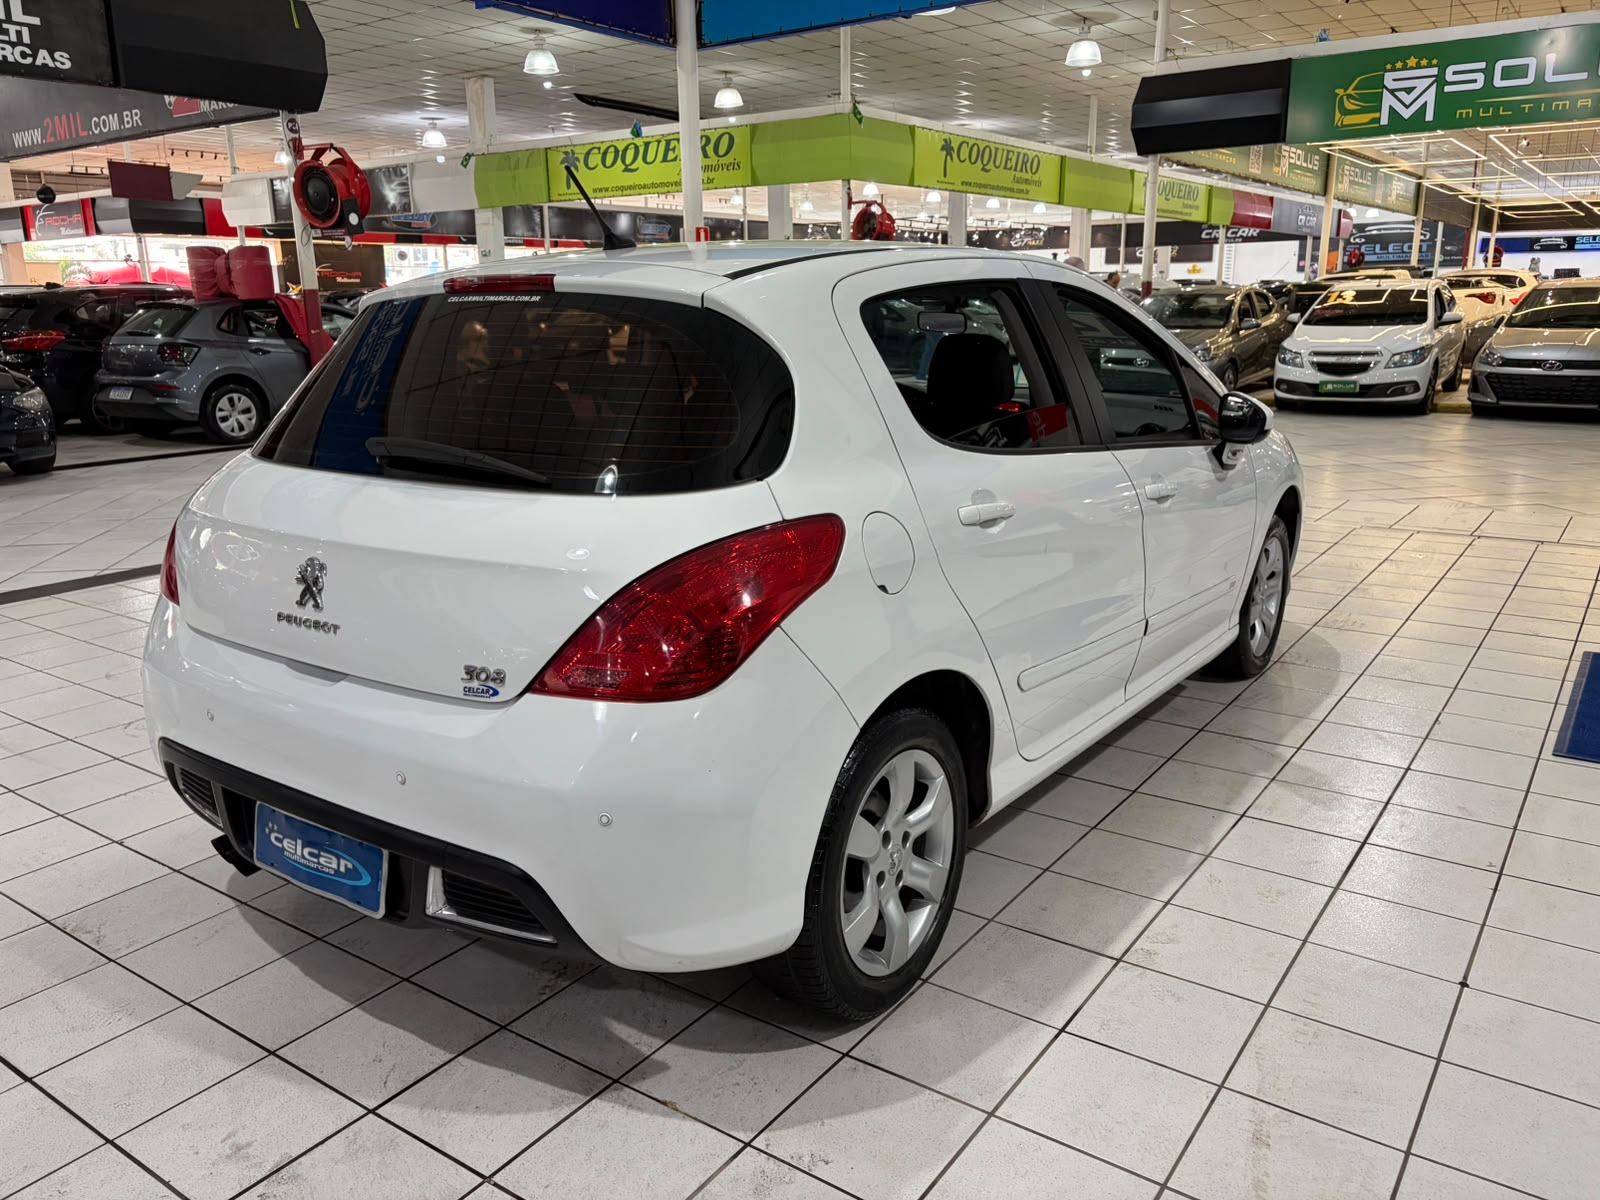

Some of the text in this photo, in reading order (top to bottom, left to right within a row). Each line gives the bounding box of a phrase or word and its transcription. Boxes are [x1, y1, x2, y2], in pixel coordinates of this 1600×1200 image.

[1443, 52, 1600, 93] SOL
[583, 131, 735, 174] COQUERO
[956, 140, 1041, 176] COQUEIRO
[1289, 146, 1320, 171] SOLUS
[676, 158, 742, 176] móveis
[1157, 178, 1200, 202] OQUEIRO
[1226, 227, 1260, 238] CAR
[448, 294, 541, 303] CELCARMULTIMARCAS.COM.BR
[276, 611, 341, 636] PEUGEOT
[460, 664, 507, 688] 308
[463, 685, 491, 696] CELCAR
[270, 832, 354, 874] celcar
[283, 850, 335, 875] multimarcas
